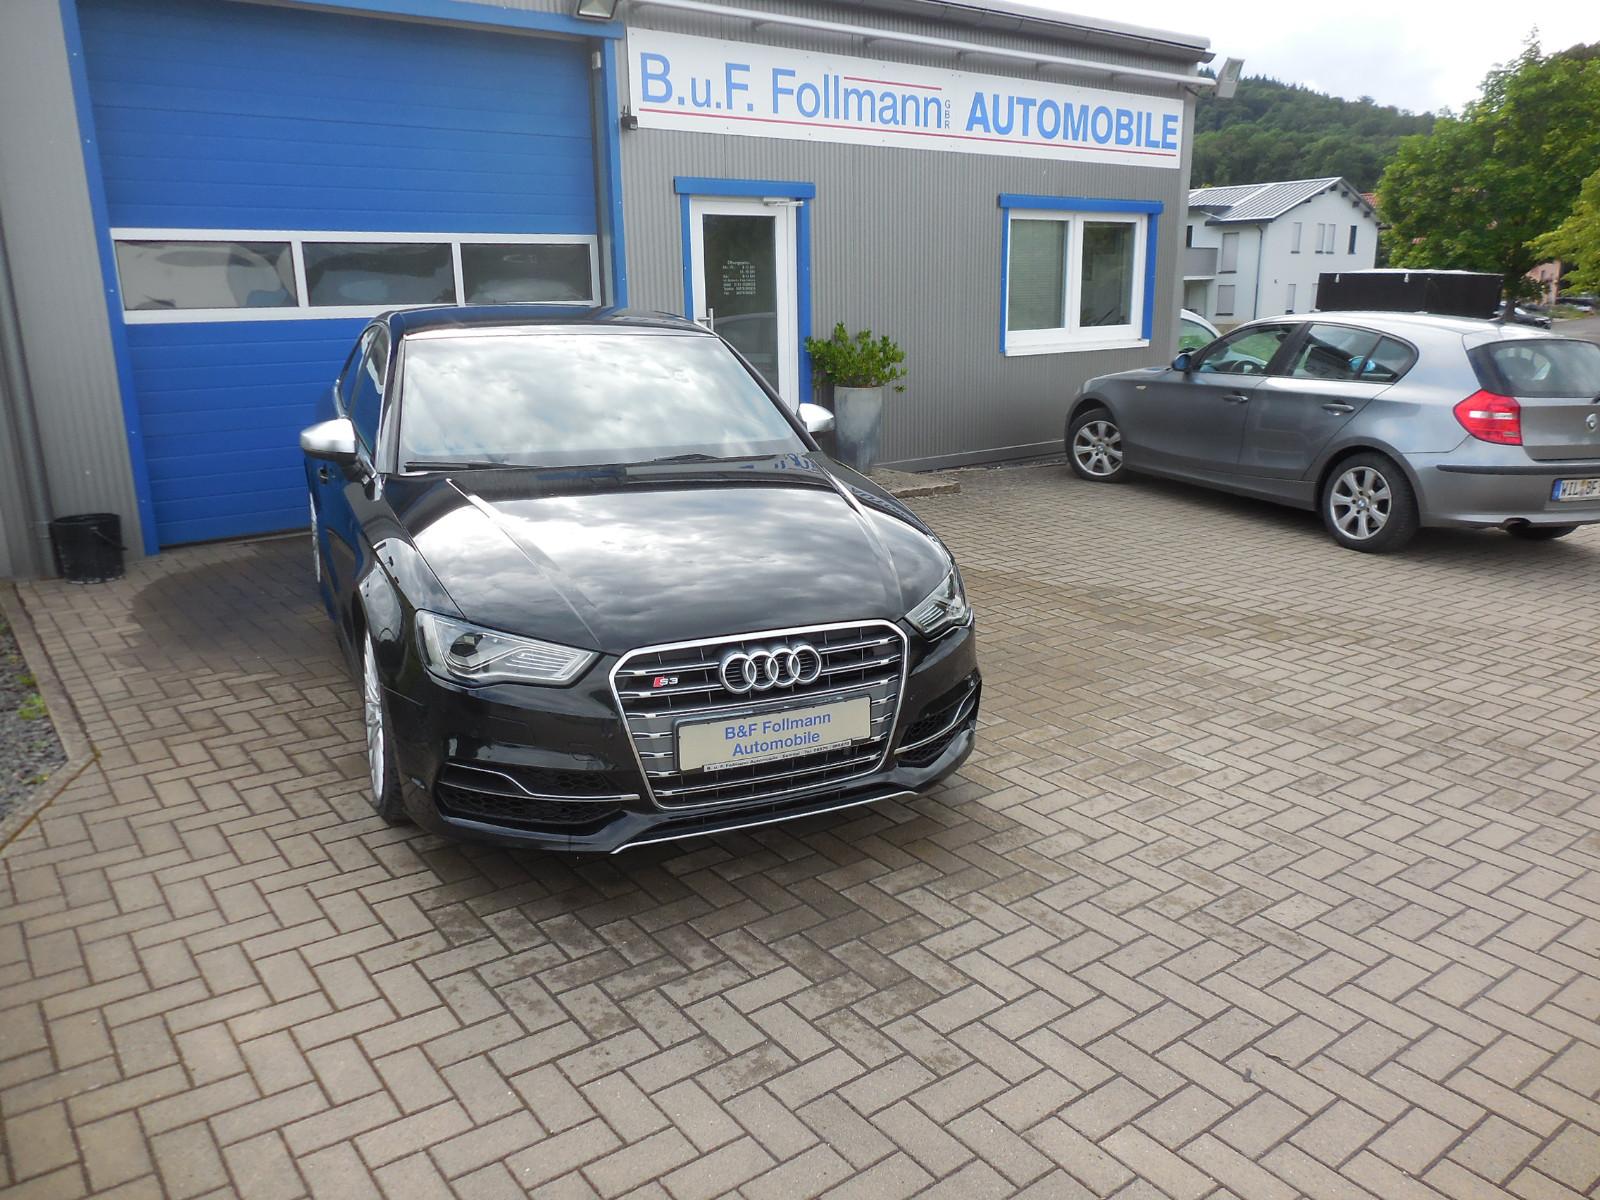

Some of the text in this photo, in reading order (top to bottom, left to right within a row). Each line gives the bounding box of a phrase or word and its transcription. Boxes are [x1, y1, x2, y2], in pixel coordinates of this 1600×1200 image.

[771, 67, 943, 130] Follmann
[965, 91, 1179, 151] AUTOMOBILE
[1560, 480, 1578, 497] WIL
[656, 677, 679, 686] S3
[724, 711, 832, 741] B&F Follmann
[732, 731, 820, 757] Automobile
